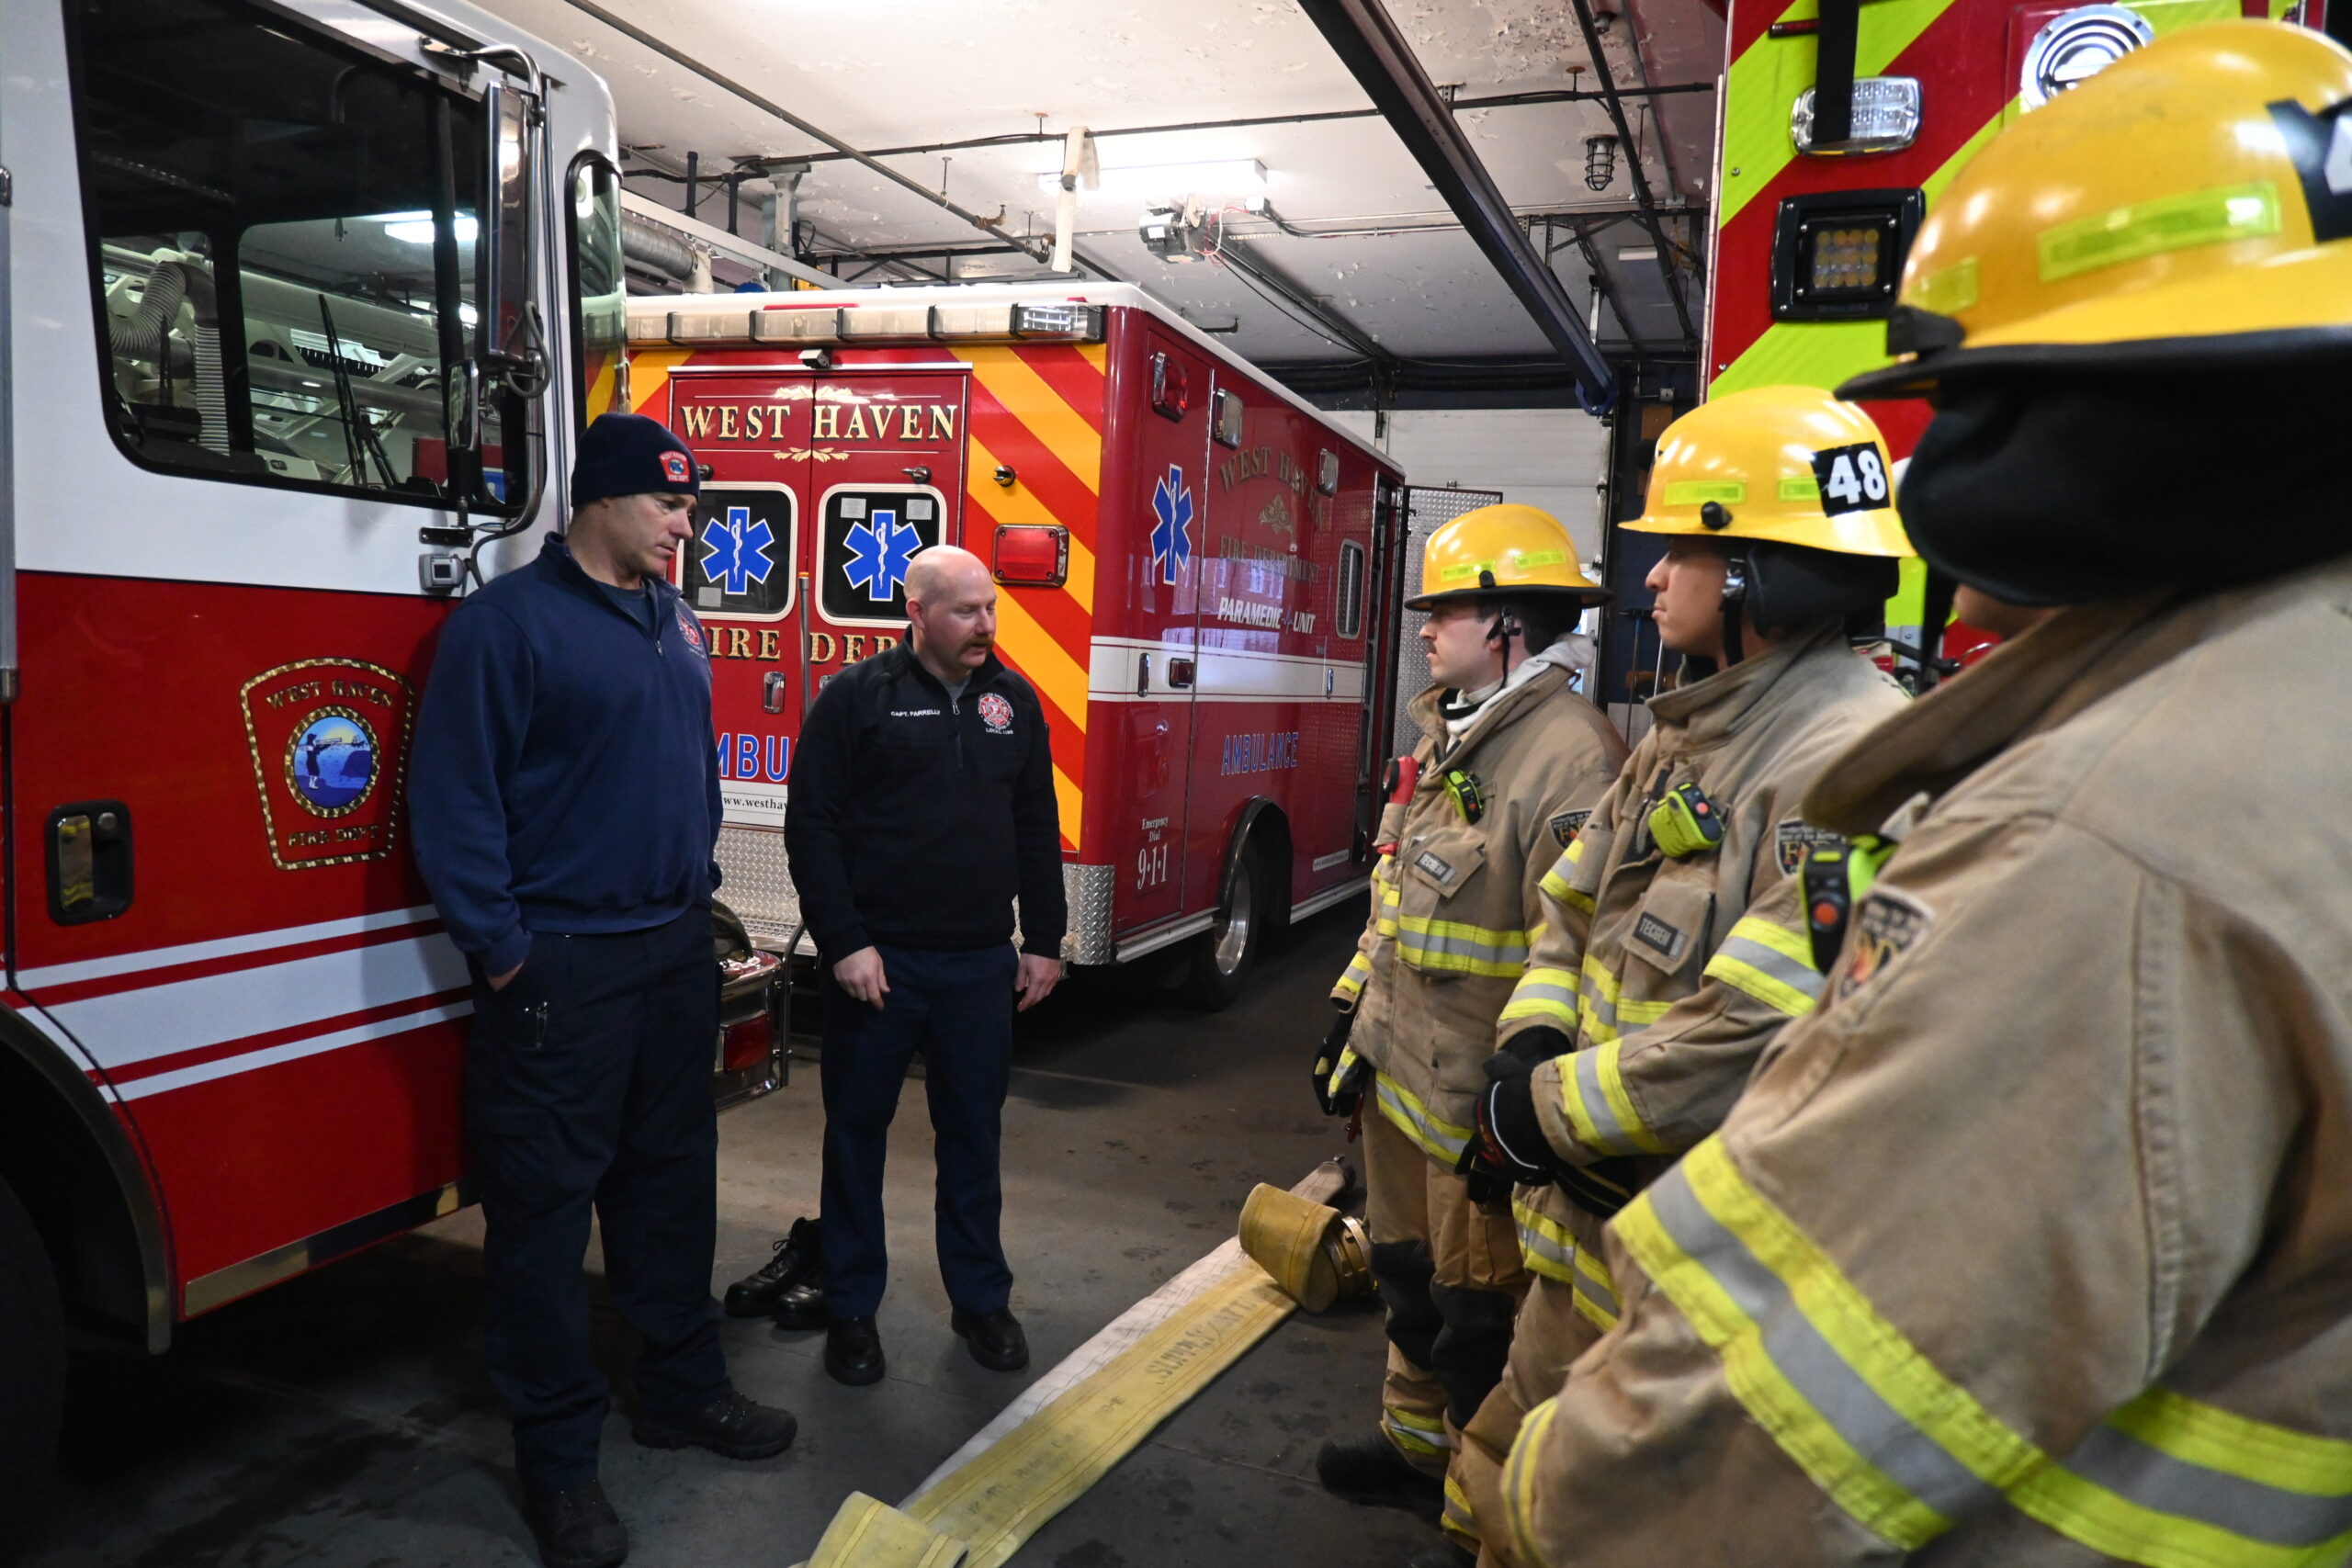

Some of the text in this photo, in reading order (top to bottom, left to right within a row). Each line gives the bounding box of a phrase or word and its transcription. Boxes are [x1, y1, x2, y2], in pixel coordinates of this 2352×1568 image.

[681, 403, 958, 442] WEST HAVEN
[1219, 446, 1326, 531] WEST HAVEN
[1827, 449, 1886, 504] 48
[1220, 535, 1322, 584] FIRE DEPARTMENT
[1217, 597, 1316, 634] PARAMEDIC UNIT
[703, 626, 781, 661] IRE
[266, 681, 392, 710] WEST HAVEN
[1221, 732, 1299, 776] AMBULANCE
[288, 829, 330, 846] FIRE
[1142, 816, 1170, 830] Emergency
[1148, 829, 1161, 842] Dial
